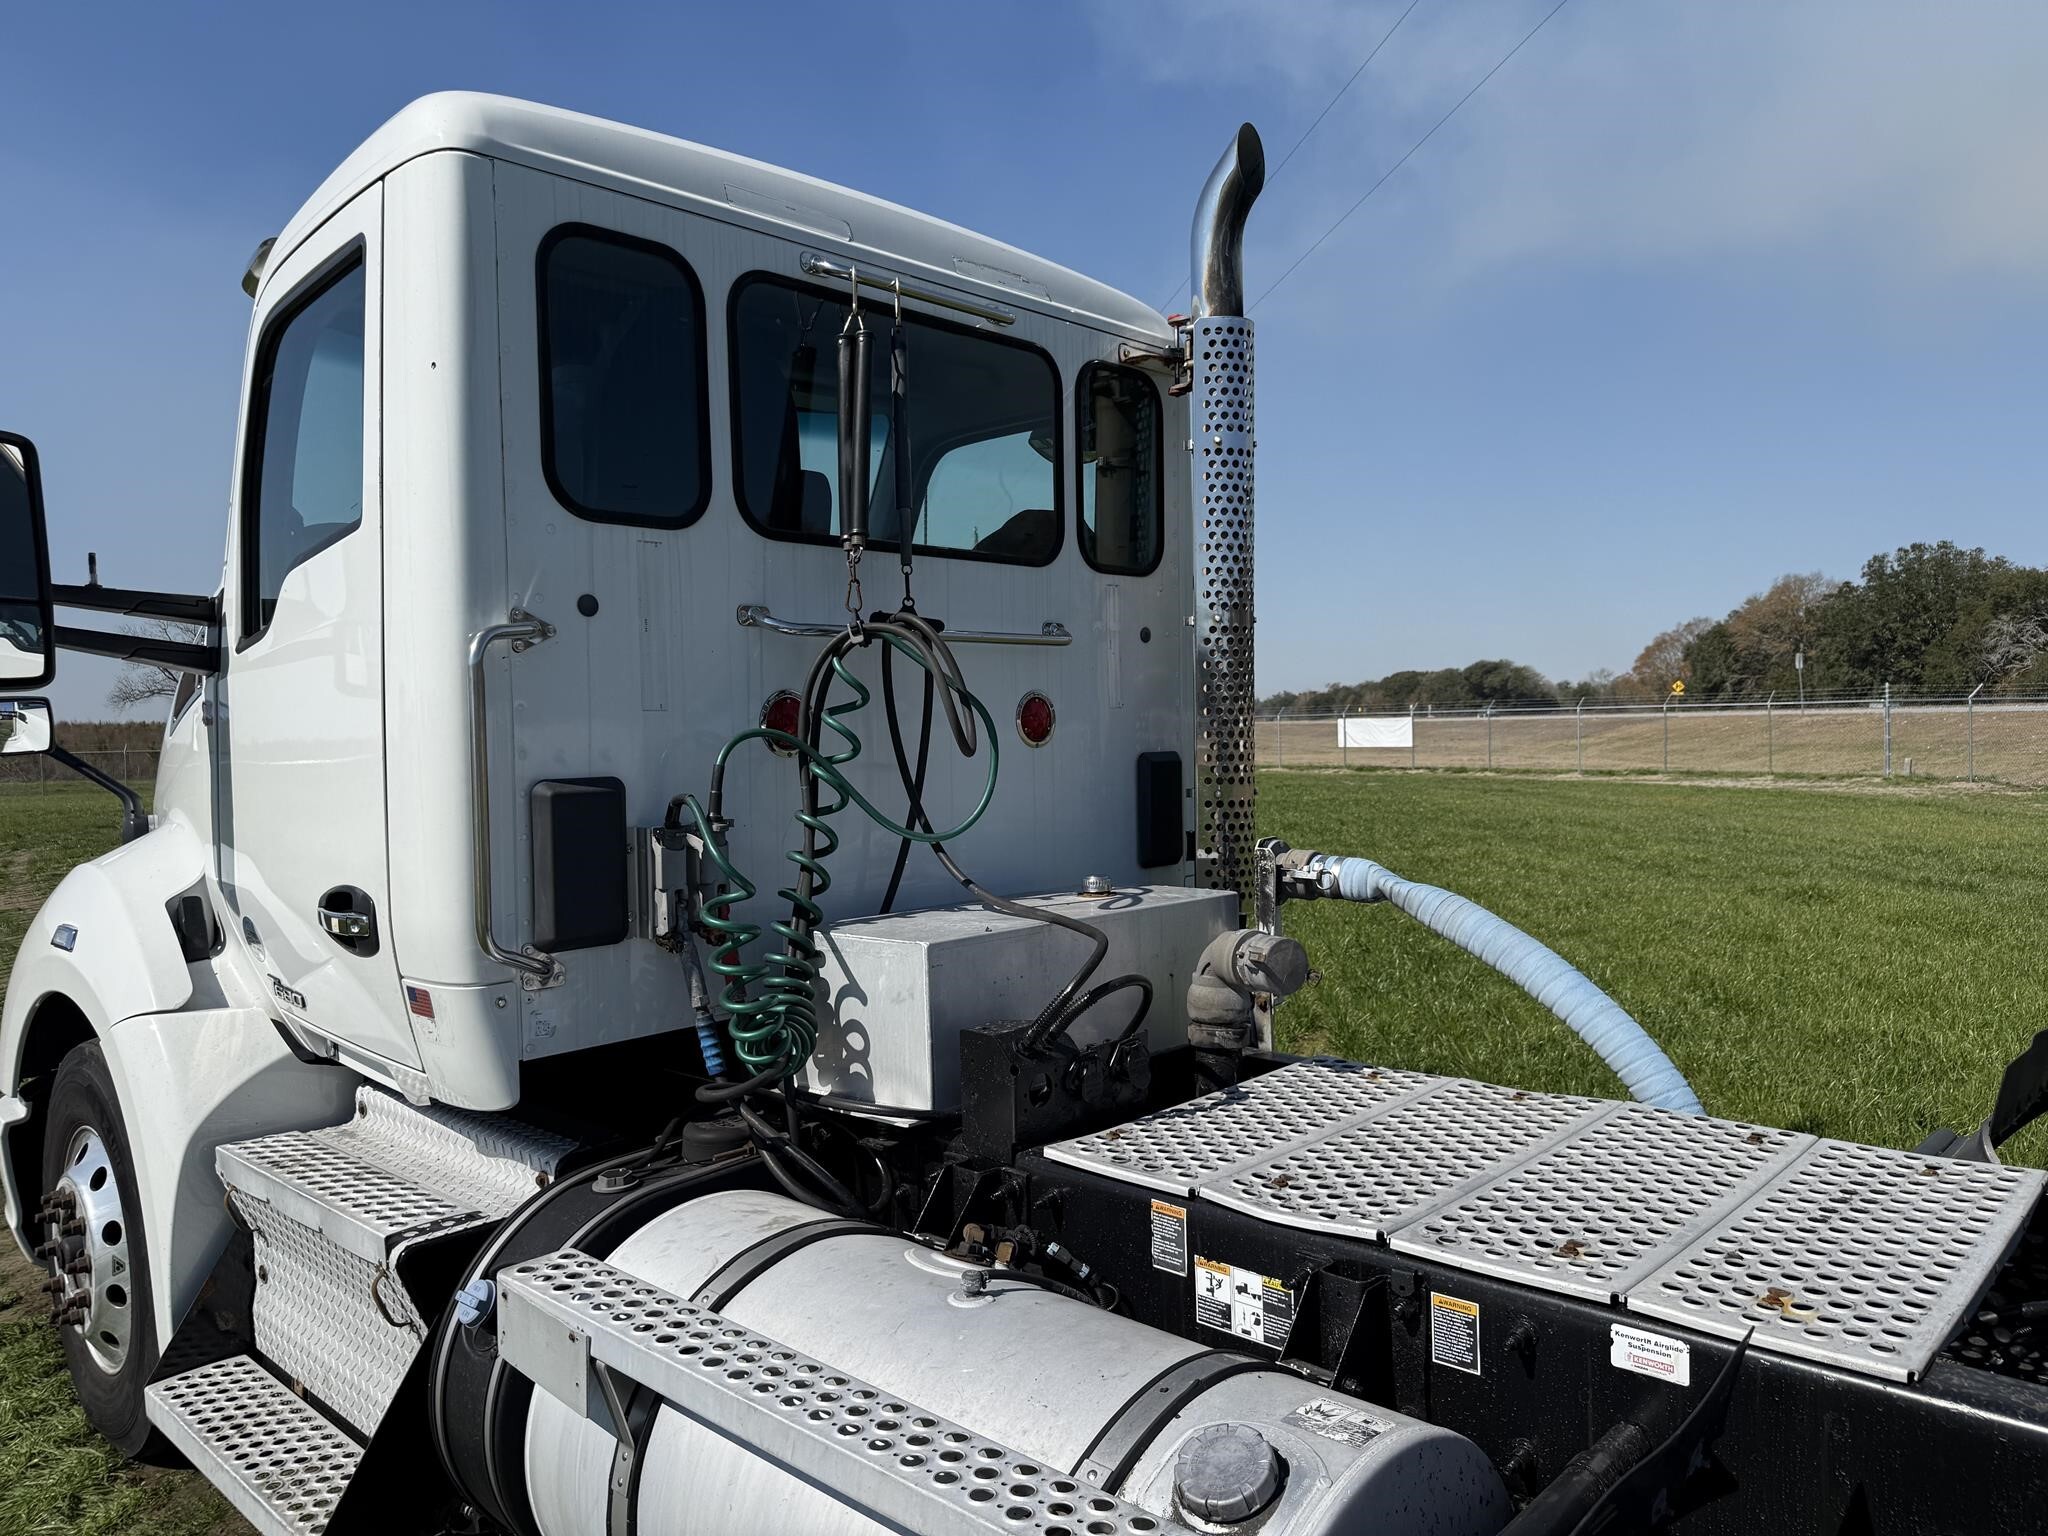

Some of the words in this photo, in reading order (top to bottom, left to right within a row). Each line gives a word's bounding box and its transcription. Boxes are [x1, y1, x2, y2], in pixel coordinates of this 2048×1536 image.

[266, 973, 307, 1010] T680
[1442, 1300, 1472, 1312] WARNING
[1614, 1330, 1652, 1345] Kenworth
[1627, 1341, 1672, 1359] Suspension
[1633, 1355, 1674, 1373] KENWORTH
